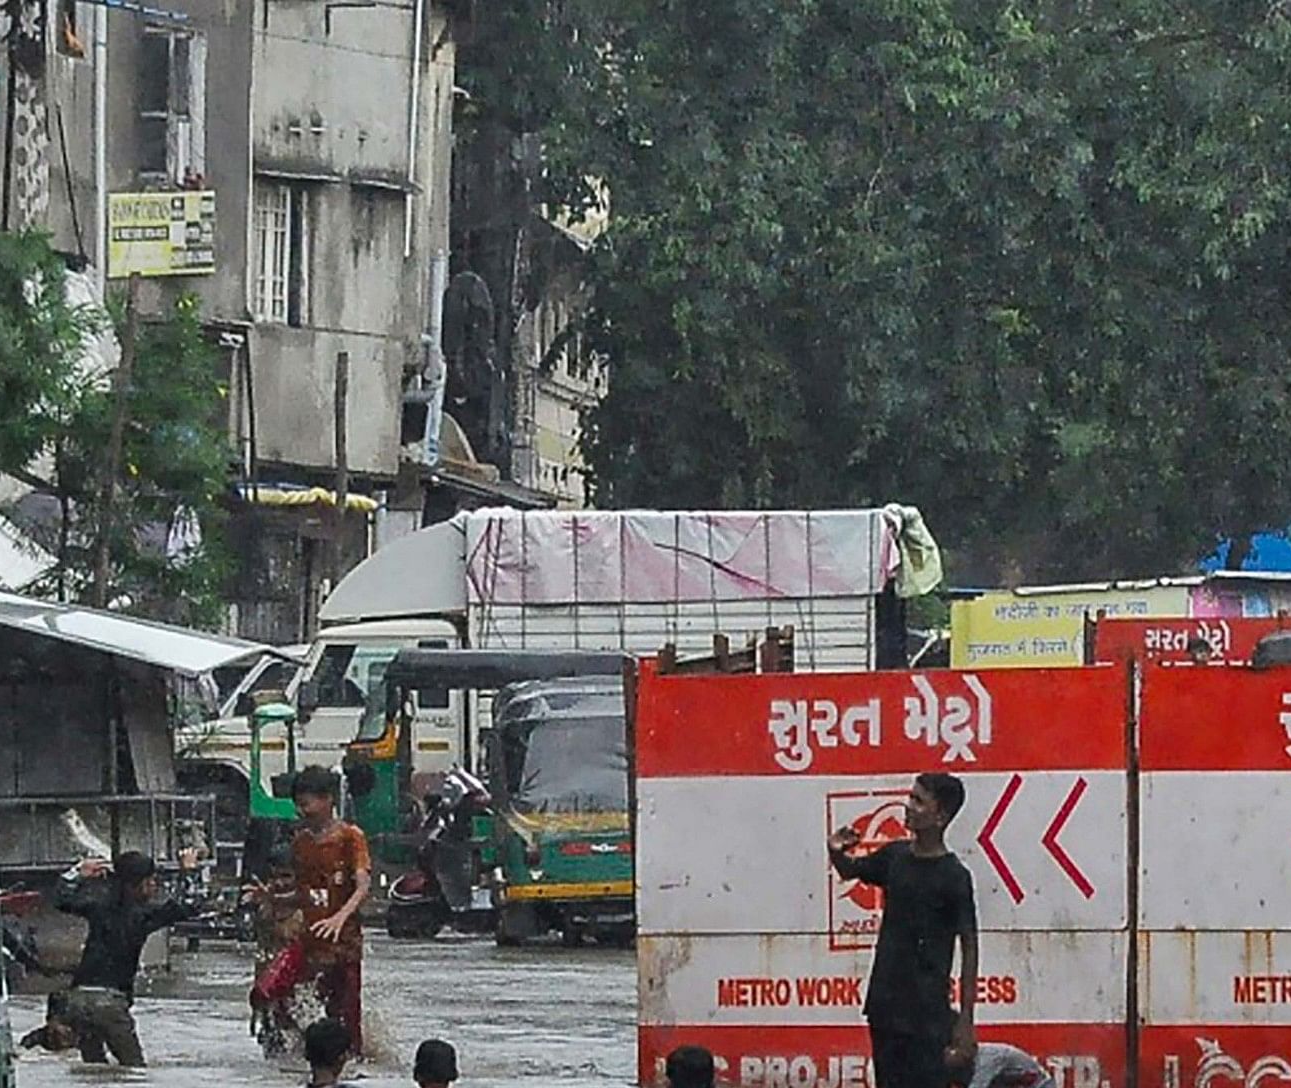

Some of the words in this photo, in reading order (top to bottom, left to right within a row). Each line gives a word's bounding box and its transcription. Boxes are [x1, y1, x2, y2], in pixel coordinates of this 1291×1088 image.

[768, 698, 881, 772] સુરત
[903, 674, 992, 762] મેટ્રો
[718, 979, 791, 1007] METRO
[796, 978, 862, 1006] WORK
